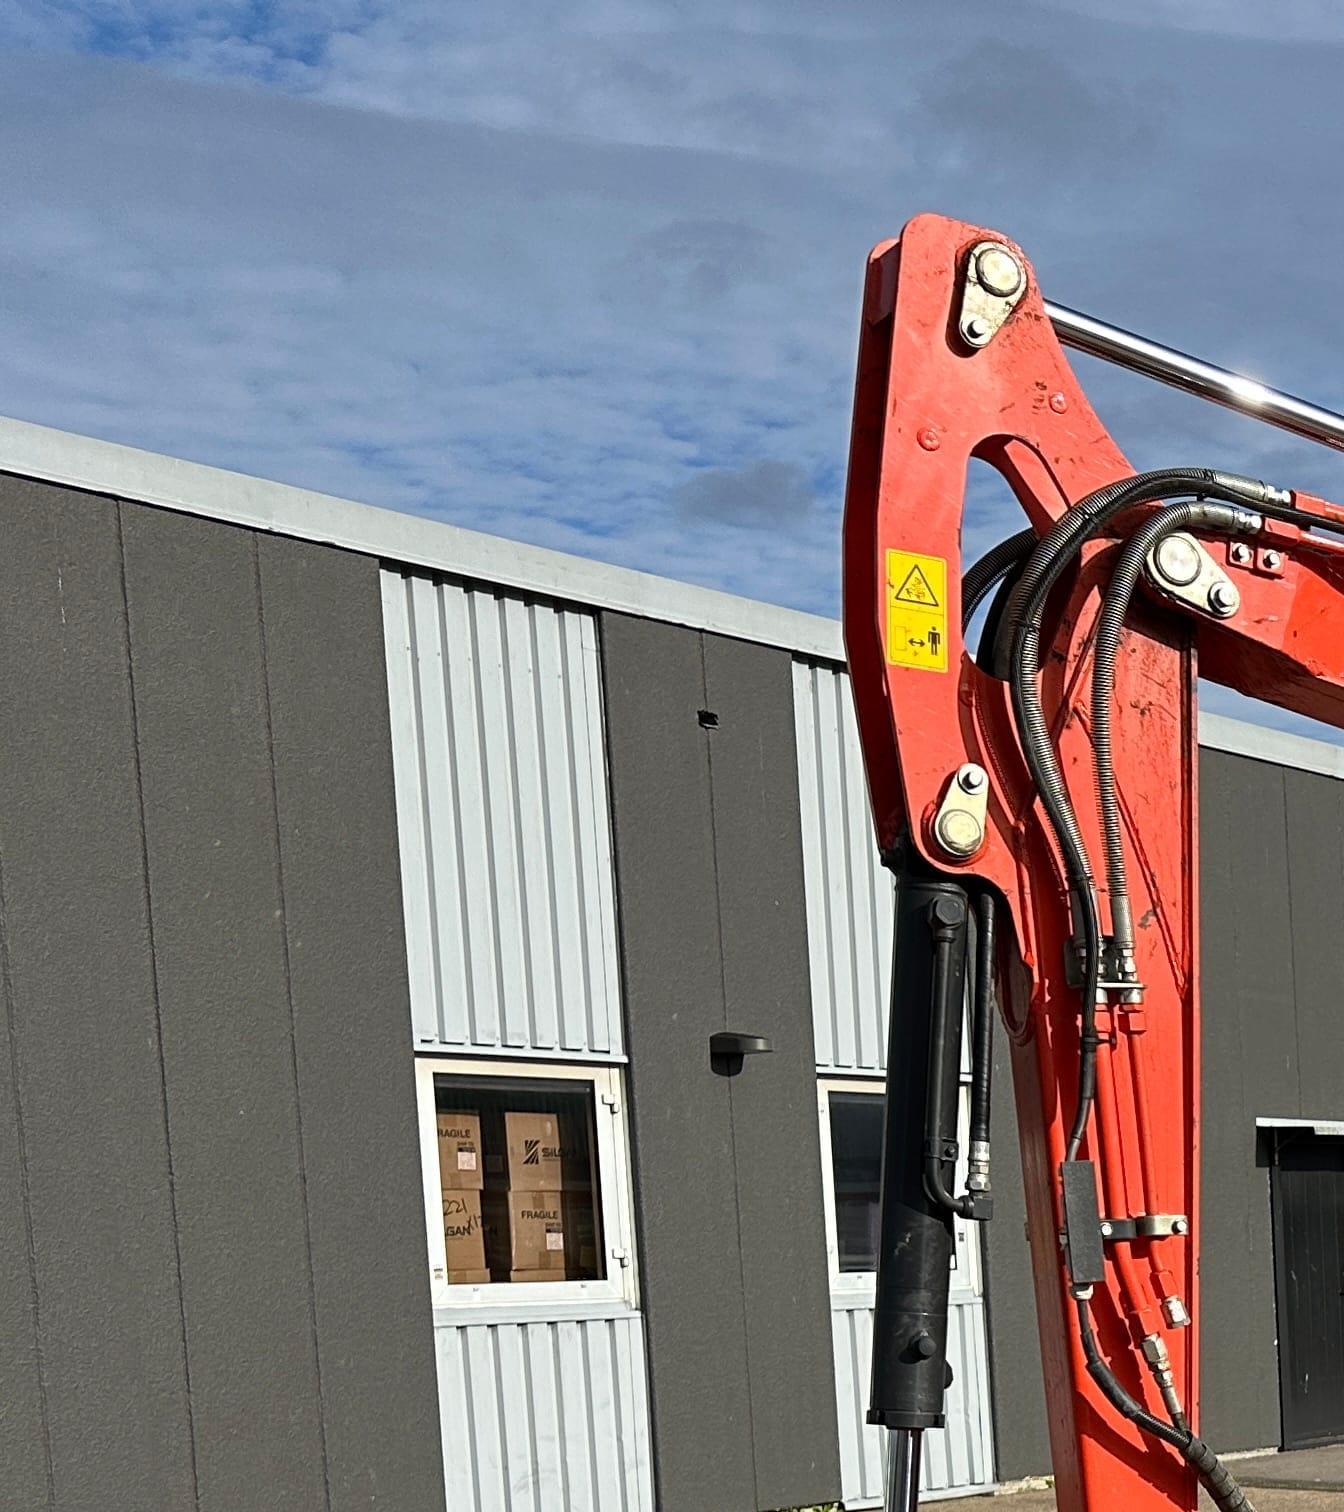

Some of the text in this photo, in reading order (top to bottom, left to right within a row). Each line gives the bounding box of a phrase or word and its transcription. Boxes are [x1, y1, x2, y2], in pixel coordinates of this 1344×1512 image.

[438, 1128, 470, 1138] RAGILE
[521, 1211, 558, 1219] FRAGILE
[445, 1226, 471, 1236] GAN
